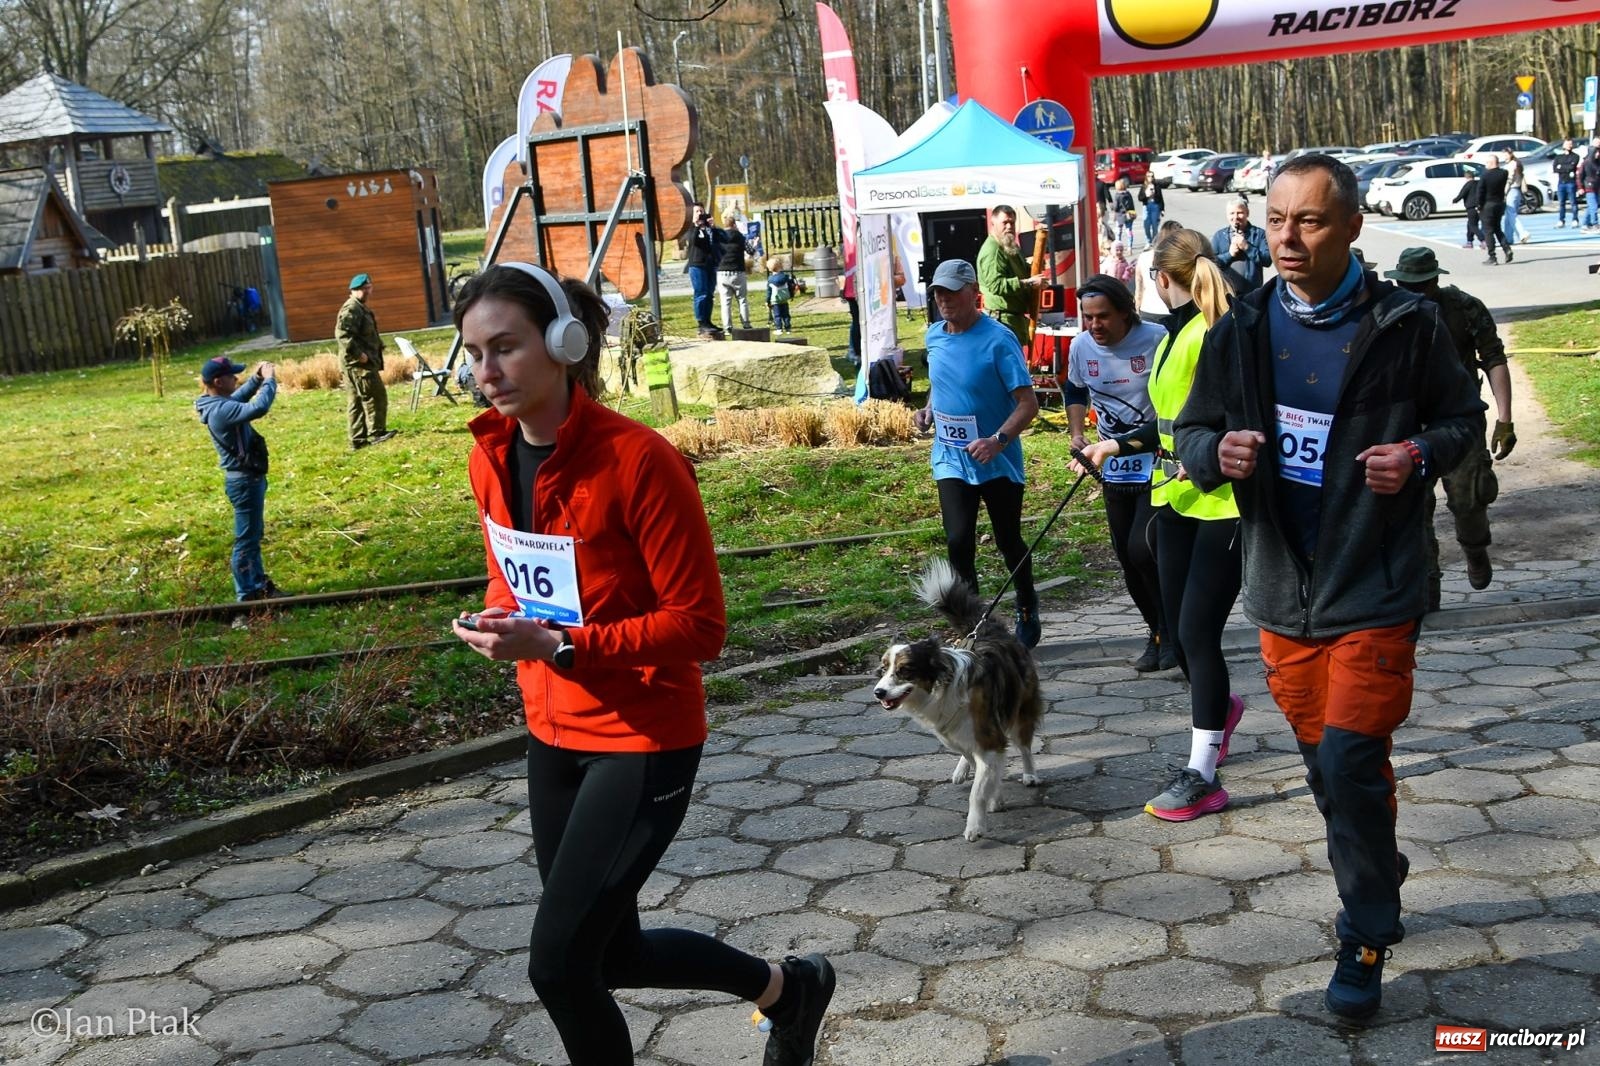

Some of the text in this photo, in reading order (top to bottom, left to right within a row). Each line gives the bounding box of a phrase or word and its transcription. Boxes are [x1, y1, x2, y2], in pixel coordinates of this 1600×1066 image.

[869, 184, 947, 202] PersonalBest
[943, 424, 968, 440] 128
[1109, 458, 1143, 472] 048
[504, 556, 554, 598] 016
